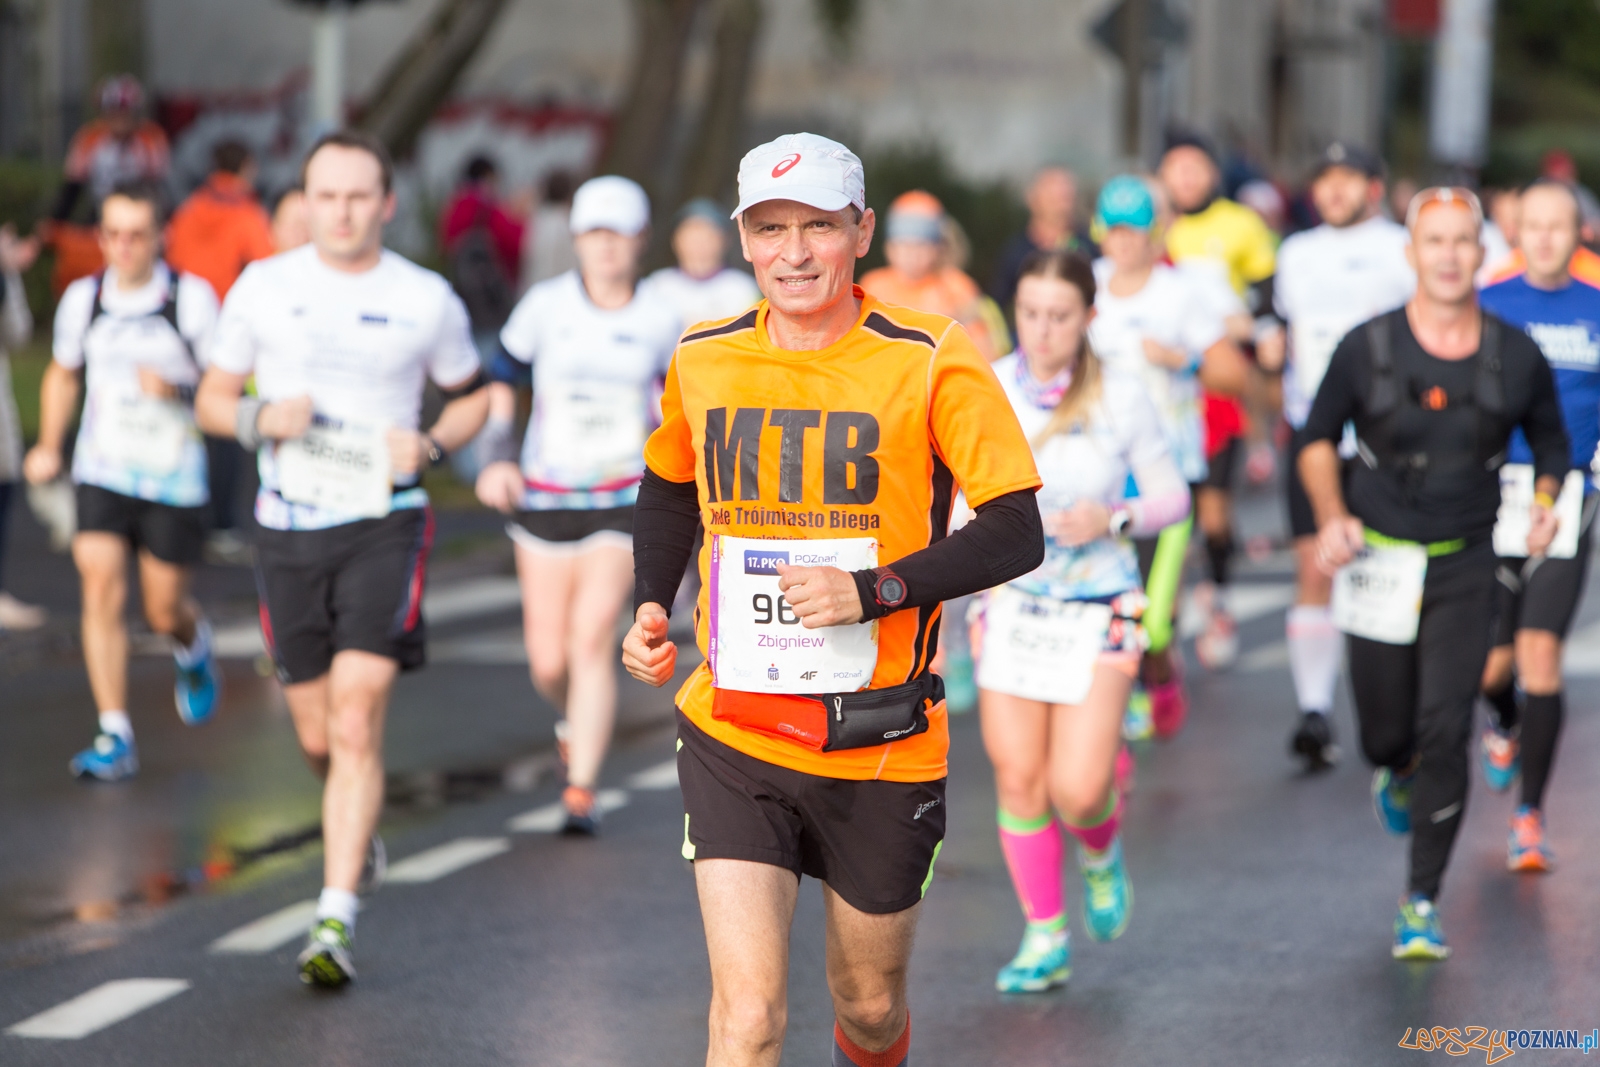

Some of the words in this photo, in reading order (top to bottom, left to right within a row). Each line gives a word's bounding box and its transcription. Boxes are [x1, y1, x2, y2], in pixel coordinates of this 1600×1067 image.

[704, 407, 880, 504] MTB
[735, 506, 825, 528] Trójmiasto
[830, 510, 880, 531] Biega
[757, 634, 825, 650] Zbigniew
